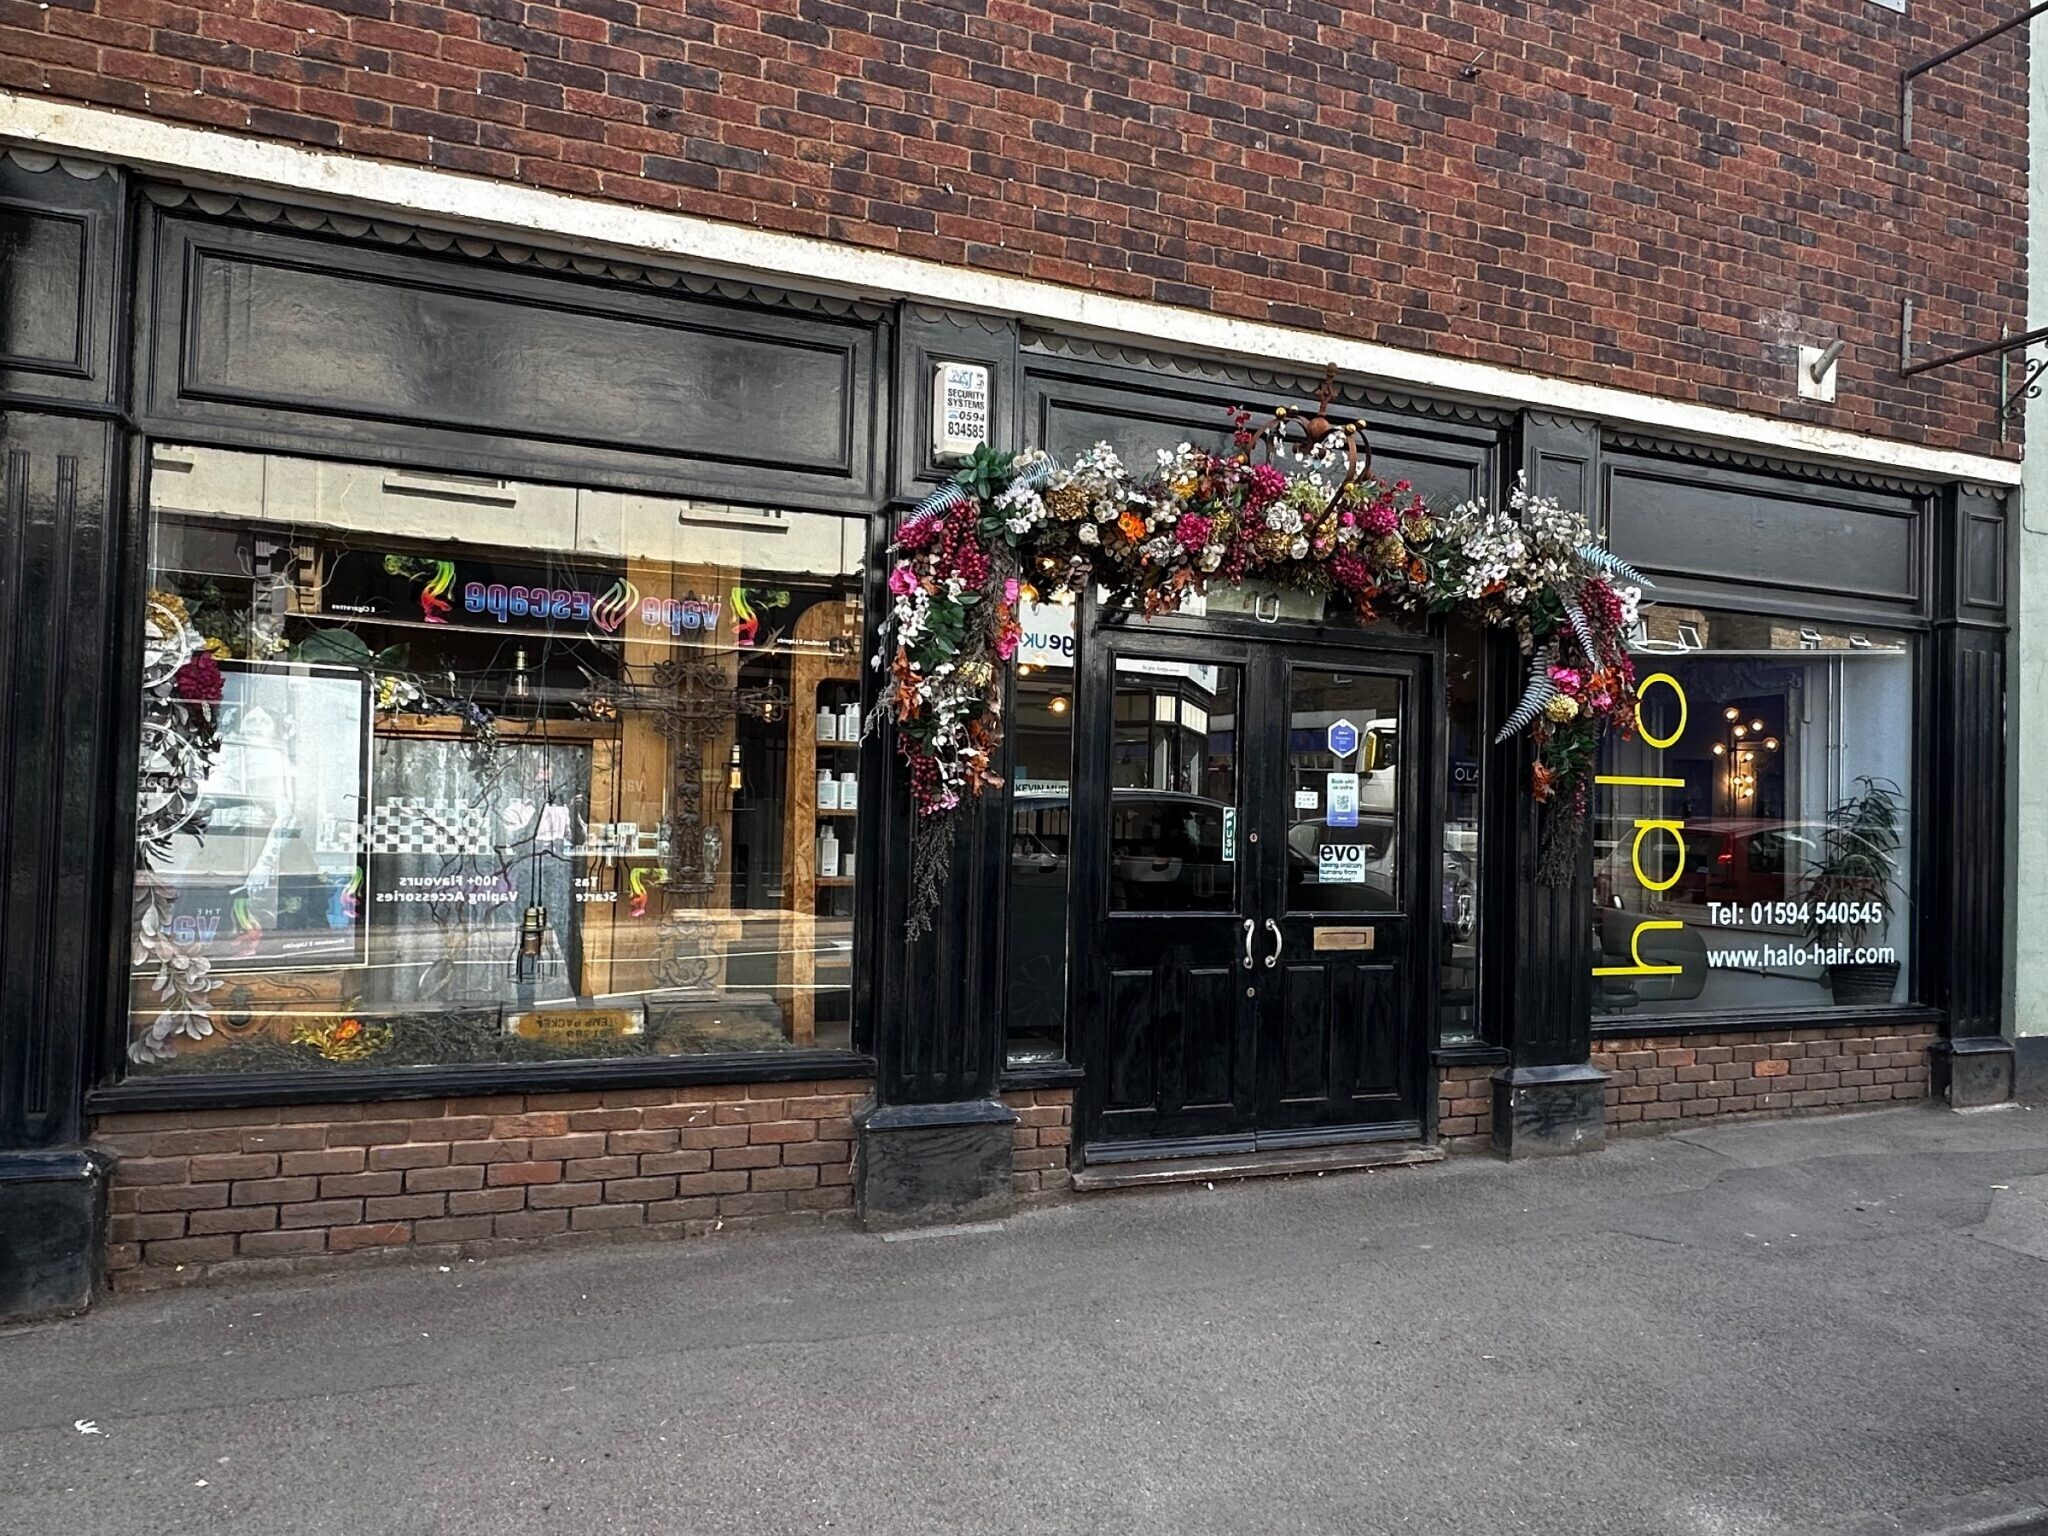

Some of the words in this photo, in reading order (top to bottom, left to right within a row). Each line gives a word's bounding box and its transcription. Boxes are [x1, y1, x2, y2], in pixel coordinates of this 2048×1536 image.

[947, 388, 985, 400] SECURITY
[947, 399, 985, 410] SYSTEMS
[959, 411, 985, 422] 0594
[947, 421, 985, 439] 834585
[1590, 672, 1688, 977] halo
[1707, 902, 1744, 925] Tel:
[1751, 902, 1810, 925] 01594
[1815, 902, 1882, 924] 540545
[1706, 942, 1895, 969] www.halo-hair.com
